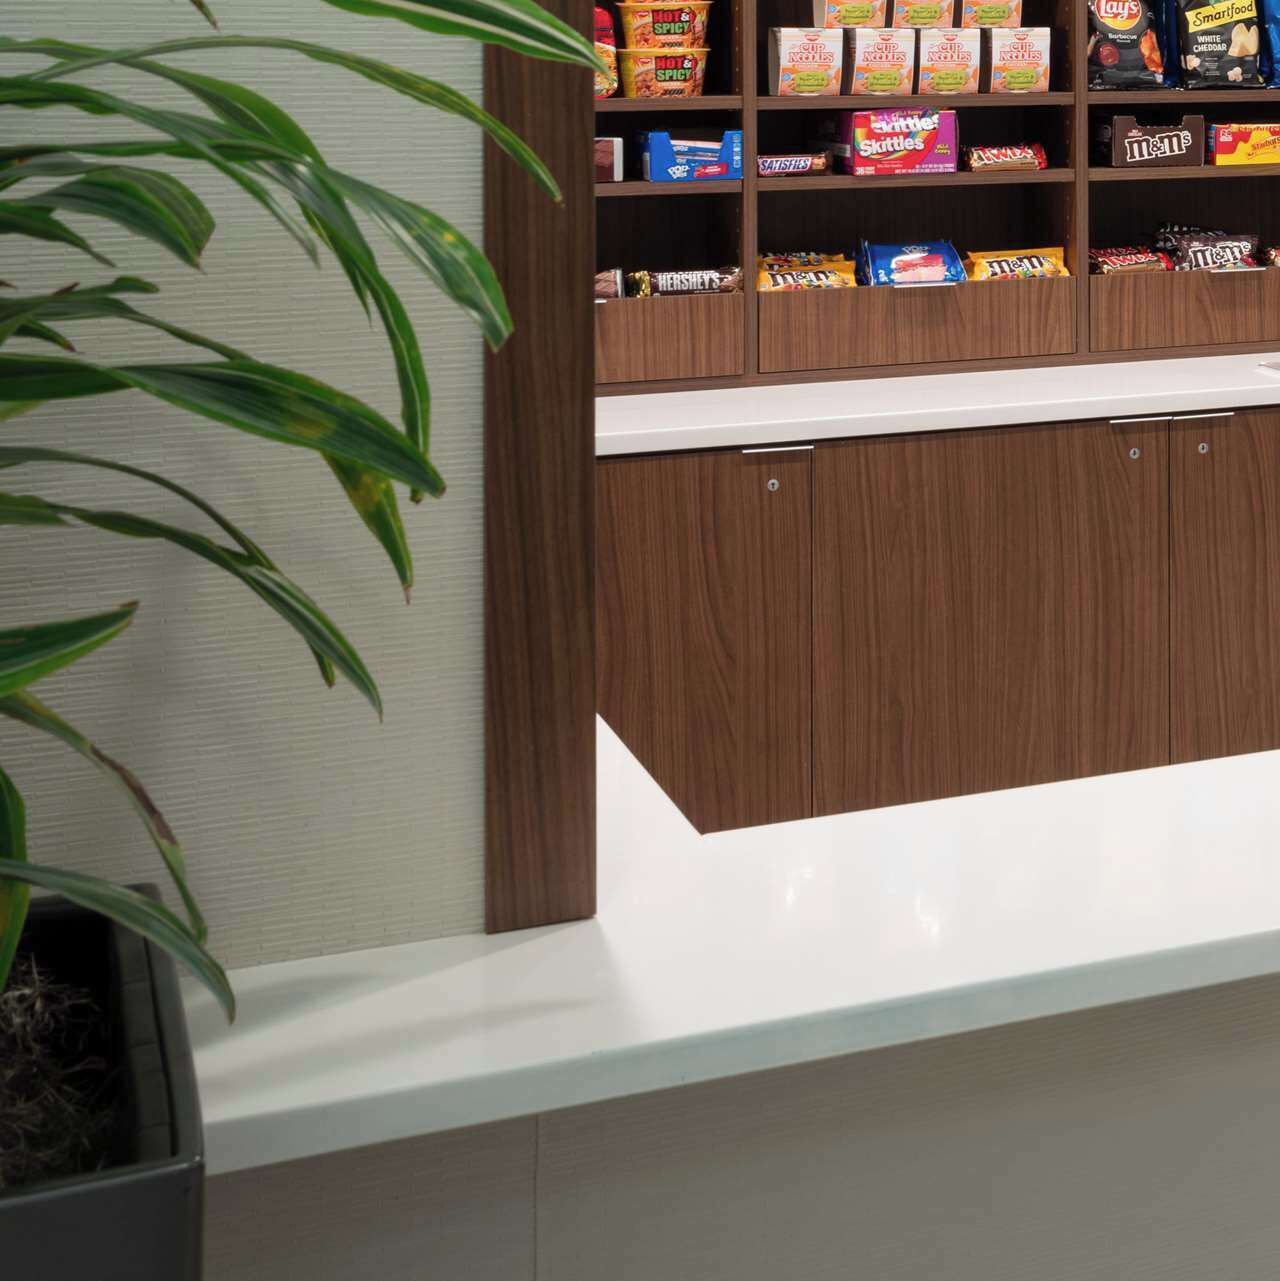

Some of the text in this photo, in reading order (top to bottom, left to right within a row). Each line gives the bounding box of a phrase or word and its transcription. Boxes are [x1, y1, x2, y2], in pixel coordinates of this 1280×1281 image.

[1100, 0, 1140, 20] Lay's
[1193, 2, 1253, 27] Smartfood
[654, 23, 690, 34] SPICY
[1197, 35, 1221, 43] WHITE
[799, 43, 825, 53] CUP
[873, 43, 899, 52] CUP
[938, 43, 962, 52] CUP
[1009, 43, 1033, 52] CUP
[1193, 44, 1227, 52] CHEDDAR
[656, 69, 691, 81] SPICY
[859, 136, 924, 157] Skittles
[972, 147, 1034, 163] TWIX
[760, 159, 809, 171] SATISFIES
[1099, 253, 1158, 267] TWIX
[659, 273, 720, 291] HERSHEY'S
